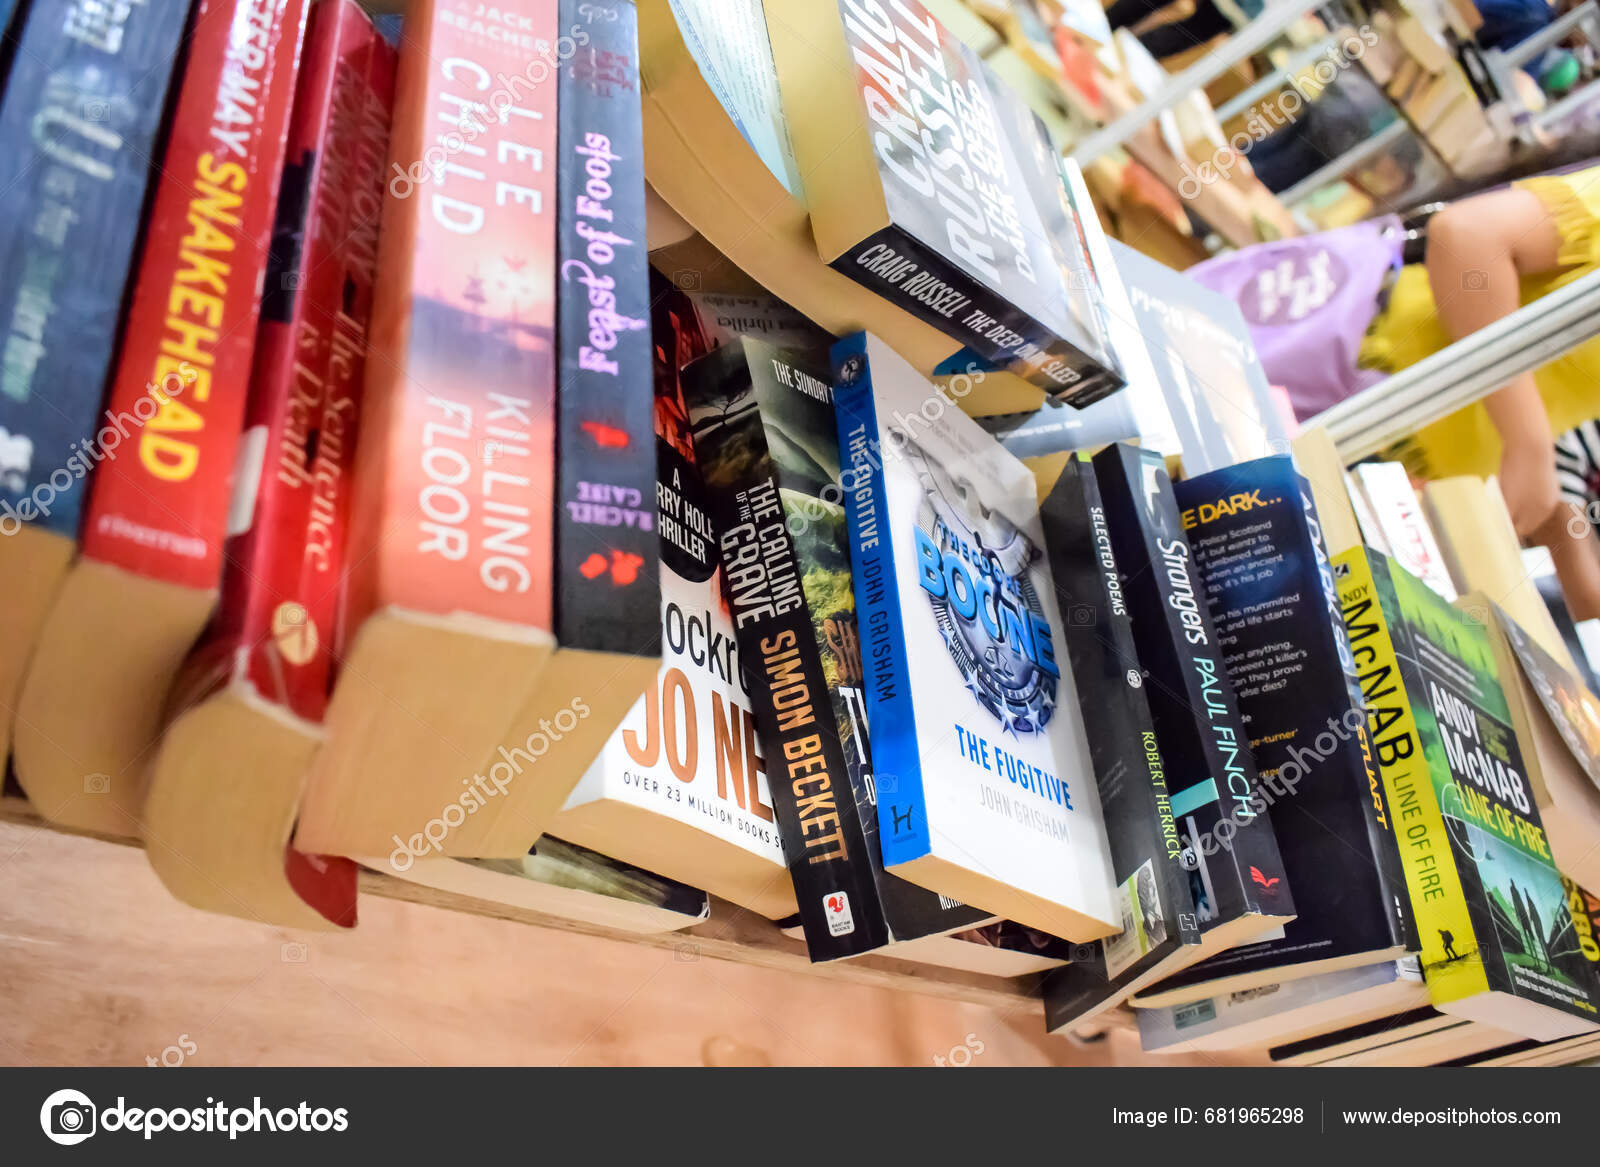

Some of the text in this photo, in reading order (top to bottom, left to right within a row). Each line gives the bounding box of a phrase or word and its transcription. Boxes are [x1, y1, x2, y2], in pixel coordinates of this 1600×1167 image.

[474, 3, 533, 31] JACK
[208, 70, 262, 158] MAY
[431, 56, 492, 235] CHILD
[495, 102, 543, 215] LEE
[574, 131, 623, 223] Fools
[575, 220, 634, 266] of
[139, 152, 248, 482] SNAKEHEAD
[561, 258, 647, 377] Feast
[856, 243, 918, 284] CRAIG
[899, 270, 973, 319] RUSSELL
[961, 309, 994, 334] THE
[984, 323, 1026, 350] DEEP
[1041, 359, 1083, 385] SLEEP
[771, 359, 794, 389] THE
[794, 368, 831, 405] SUNDAY
[303, 383, 354, 573] Sentence
[416, 396, 473, 562] FLOOR
[479, 391, 532, 593] KILLING
[566, 501, 653, 531] RACHEL
[576, 481, 642, 507] CAINE
[672, 467, 682, 491] A
[735, 491, 752, 522] OF THE
[720, 522, 777, 630] GRAVE
[747, 476, 803, 617] THE CALLING
[847, 423, 897, 704] THE FUGITIVE JOHN GRISHAM
[1233, 563, 1247, 575] an
[1240, 571, 1256, 584] his
[1256, 568, 1275, 585] job
[1252, 543, 1276, 558] with
[913, 523, 1062, 681] BOONE
[1226, 619, 1246, 633] and
[1246, 614, 1263, 628] life
[1264, 607, 1294, 623] starts
[1227, 606, 1243, 620] his
[1243, 592, 1301, 615] mummified
[1090, 506, 1183, 860] SELECTED POEMS ROBERT HERRICK
[1156, 536, 1258, 818] Strangers PAUL FINCH
[1239, 678, 1288, 698] else dies?
[1248, 669, 1271, 687] they
[1272, 662, 1303, 682] prove
[1299, 490, 1313, 511] A
[1356, 724, 1388, 831] STUART
[622, 667, 699, 784] JO
[760, 629, 850, 865] SIMON BECKETT
[1341, 598, 1445, 903] McNAB LINE OF FIRE
[1430, 680, 1480, 744] ANDY
[623, 771, 660, 795] OVER
[666, 784, 682, 803] 23
[688, 794, 733, 826] MILLION
[737, 817, 771, 845] BOOKS
[954, 723, 1074, 812] THE FUGITIVE
[1439, 722, 1531, 815] McNAB
[980, 783, 1071, 845] JOHN GRISHAM
[1456, 780, 1550, 860] LINE OF FIRE
